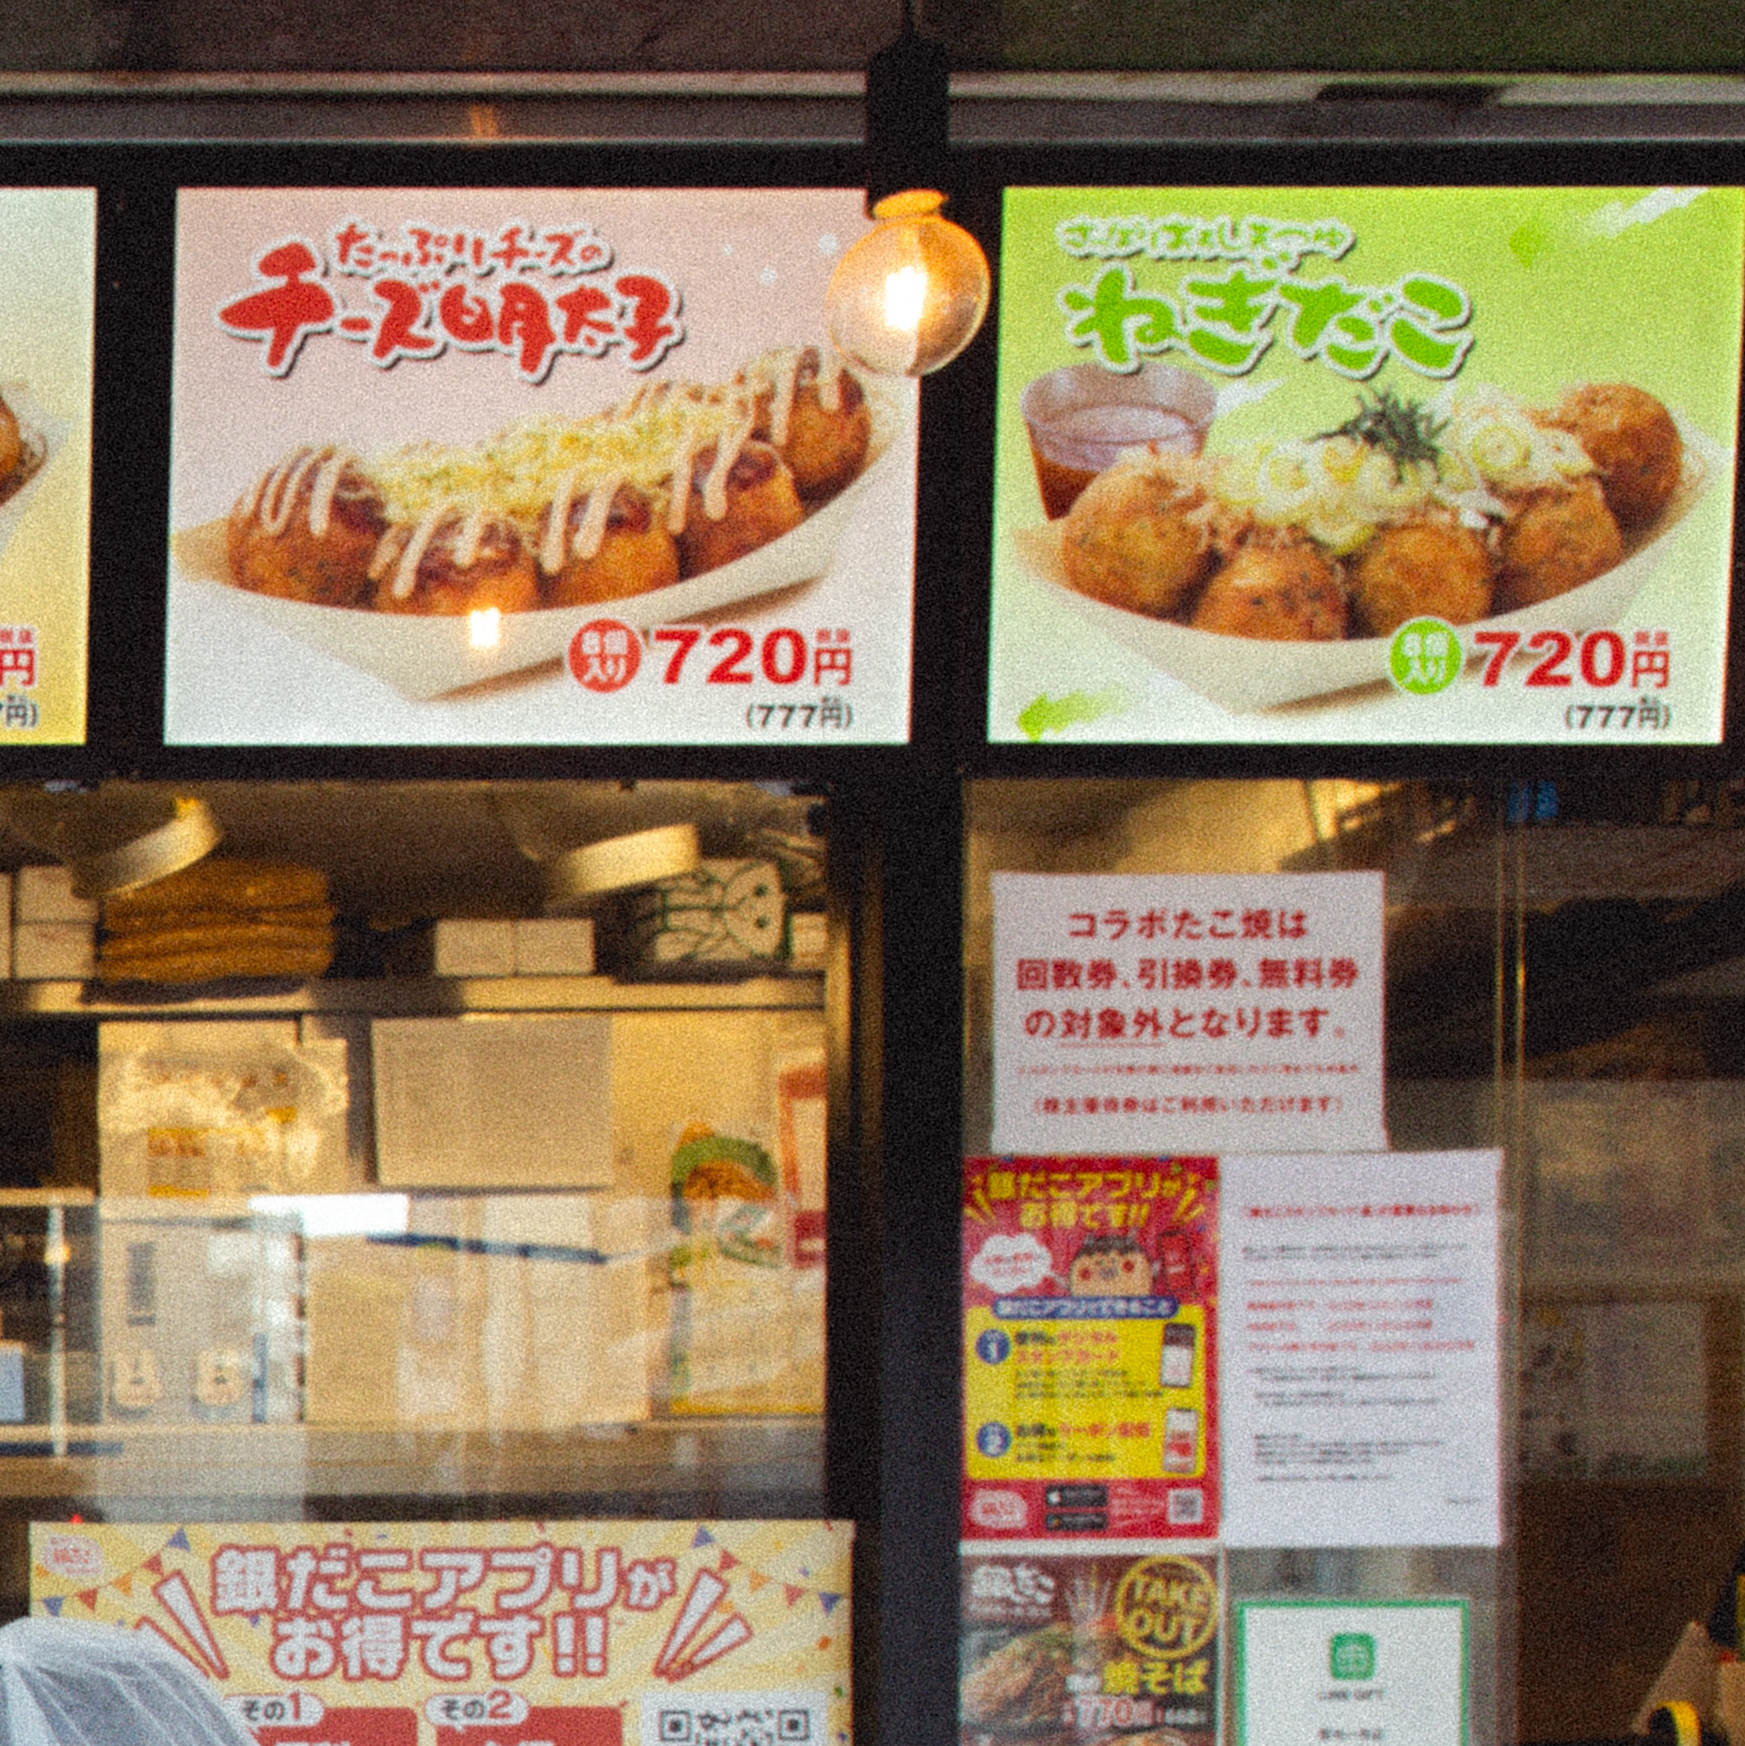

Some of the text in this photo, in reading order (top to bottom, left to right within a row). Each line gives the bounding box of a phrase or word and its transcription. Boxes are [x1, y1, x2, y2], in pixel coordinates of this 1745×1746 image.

[335, 222, 603, 268] たっぷりチーズの
[218, 241, 675, 374] チーズ明太子
[1063, 249, 1469, 372] ねぎだこ
[654, 628, 852, 686] 720円
[1473, 629, 1669, 689] 720円
[745, 702, 855, 729] (777円)
[1564, 703, 1672, 730] (777円)
[1069, 908, 1308, 940] コラボたこ焼は
[1016, 957, 1360, 992] 回数券、引換券、無料券
[1023, 1006, 1346, 1040] の対象外となります。
[212, 1544, 676, 1612] 銀だこアプリが
[1132, 1575, 1210, 1611] TAKE
[1125, 1608, 1204, 1645] OUT
[272, 1614, 607, 1680] お得です!!
[242, 1690, 302, 1722] その1
[442, 1689, 513, 1721] その2
